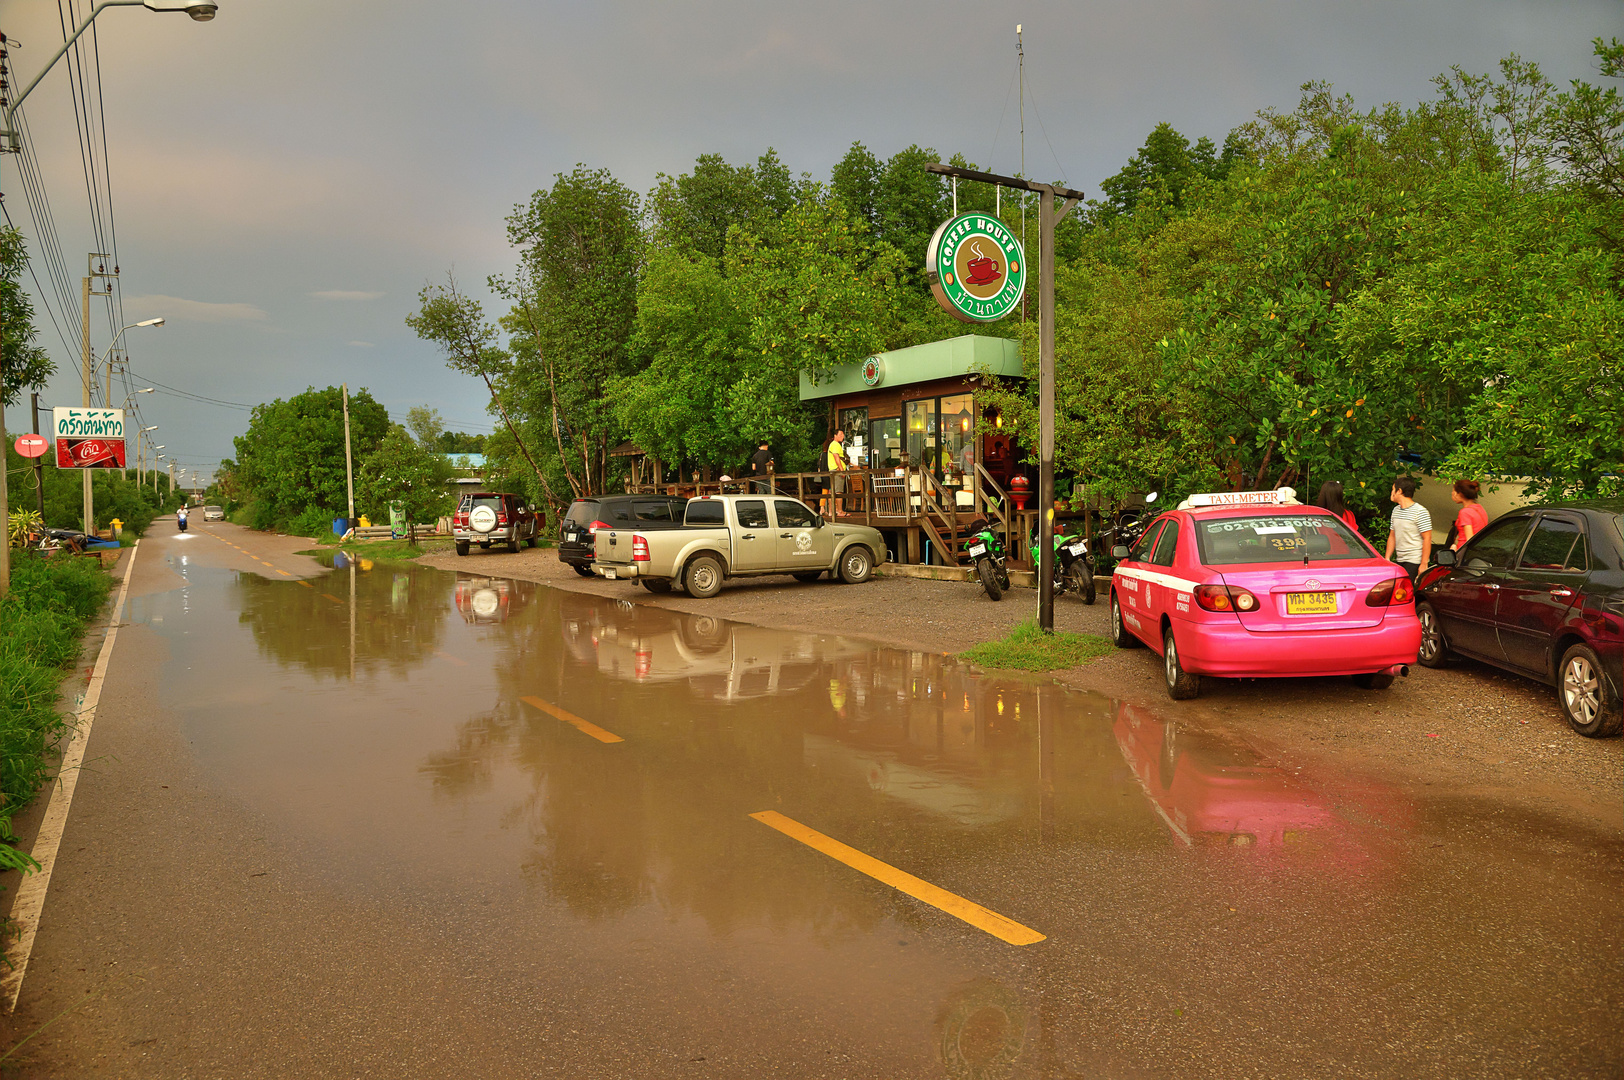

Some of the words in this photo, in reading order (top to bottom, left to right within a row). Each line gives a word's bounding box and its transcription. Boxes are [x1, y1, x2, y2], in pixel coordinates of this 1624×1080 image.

[942, 220, 972, 267] COFFEE
[977, 219, 1015, 254] HOUSE
[955, 279, 1018, 316] บ้านกาแฟ
[58, 410, 123, 436] ครัวต้นข้าว
[1208, 492, 1279, 505] TAXI-METER
[1271, 537, 1307, 547] 398
[1309, 594, 1335, 604] 3435
